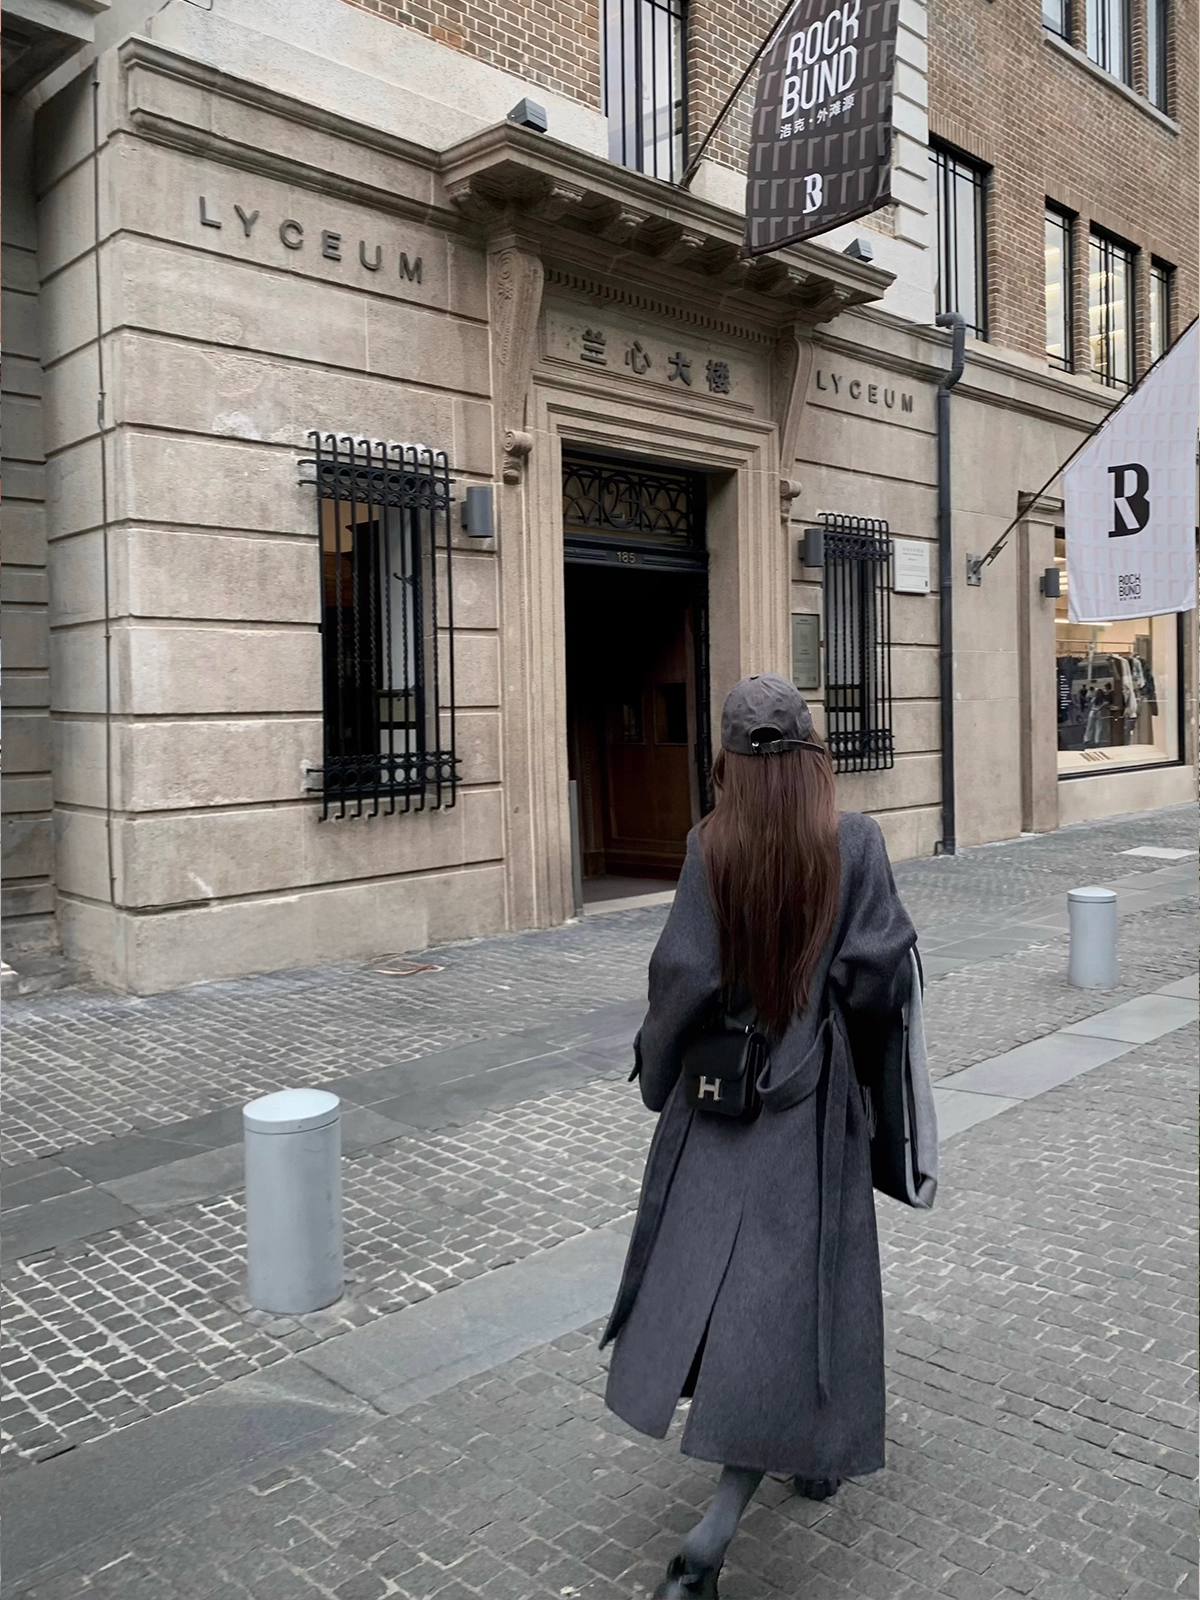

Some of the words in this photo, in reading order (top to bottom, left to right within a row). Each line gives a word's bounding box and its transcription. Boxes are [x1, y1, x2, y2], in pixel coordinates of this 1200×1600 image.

[785, 0, 861, 76] ROCK
[781, 45, 857, 120] BUND
[199, 196, 422, 284] LYCEUM
[816, 369, 913, 413] LYCEUM
[616, 551, 636, 564] 185
[1118, 573, 1141, 587] ROCK
[1118, 584, 1141, 597] BUND
[697, 1075, 722, 1101] H
